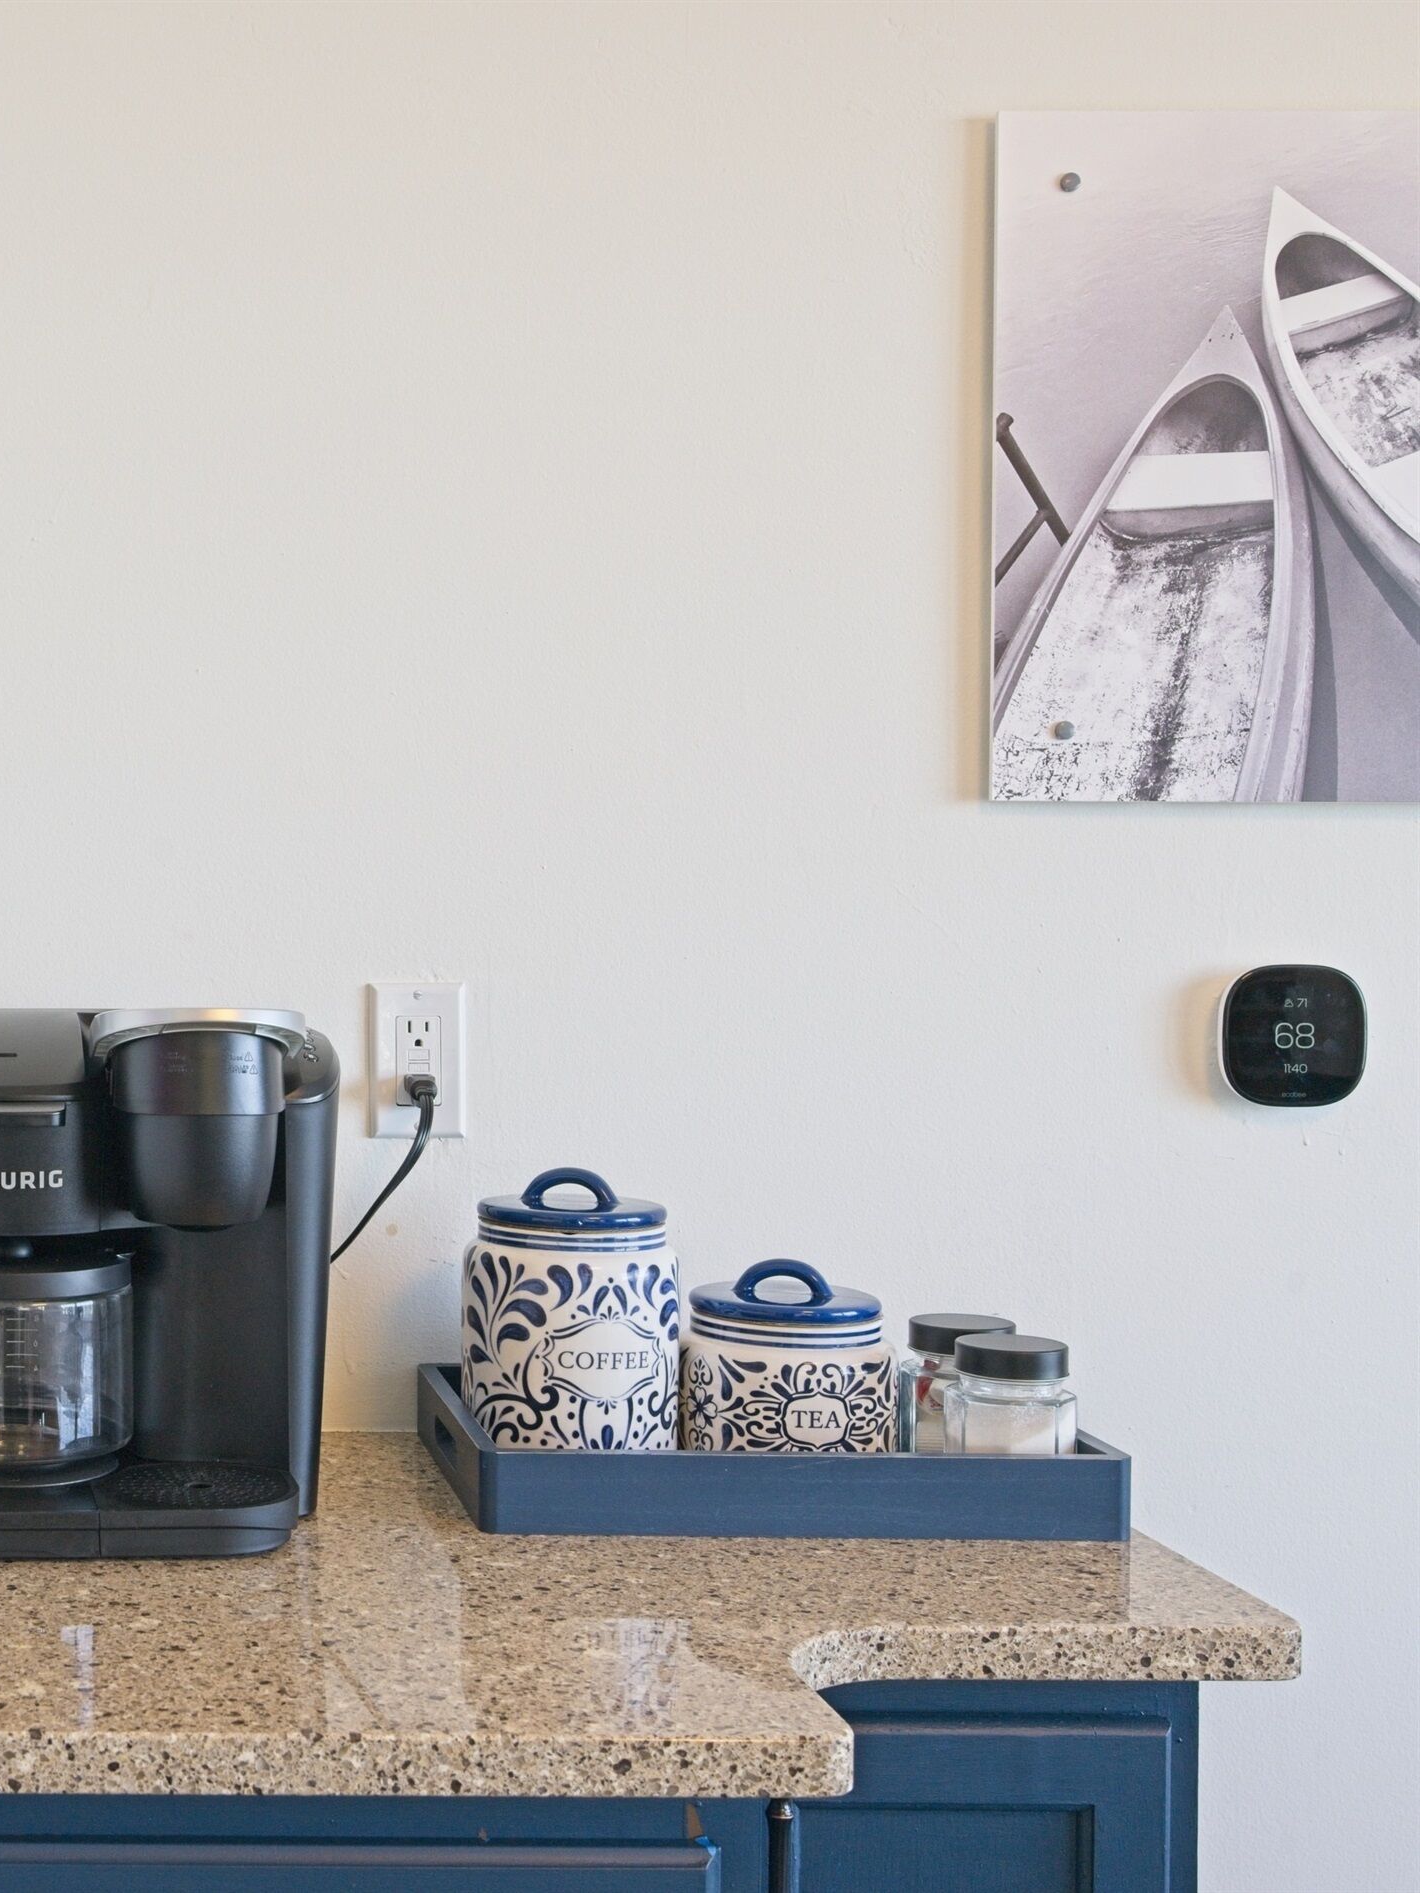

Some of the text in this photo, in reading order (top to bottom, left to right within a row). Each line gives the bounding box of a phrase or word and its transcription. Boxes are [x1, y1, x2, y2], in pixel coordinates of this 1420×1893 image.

[1297, 998, 1308, 1008] 71
[1274, 1022, 1315, 1049] 68
[558, 1350, 650, 1370] COFFEE
[791, 1410, 842, 1429] TEA
